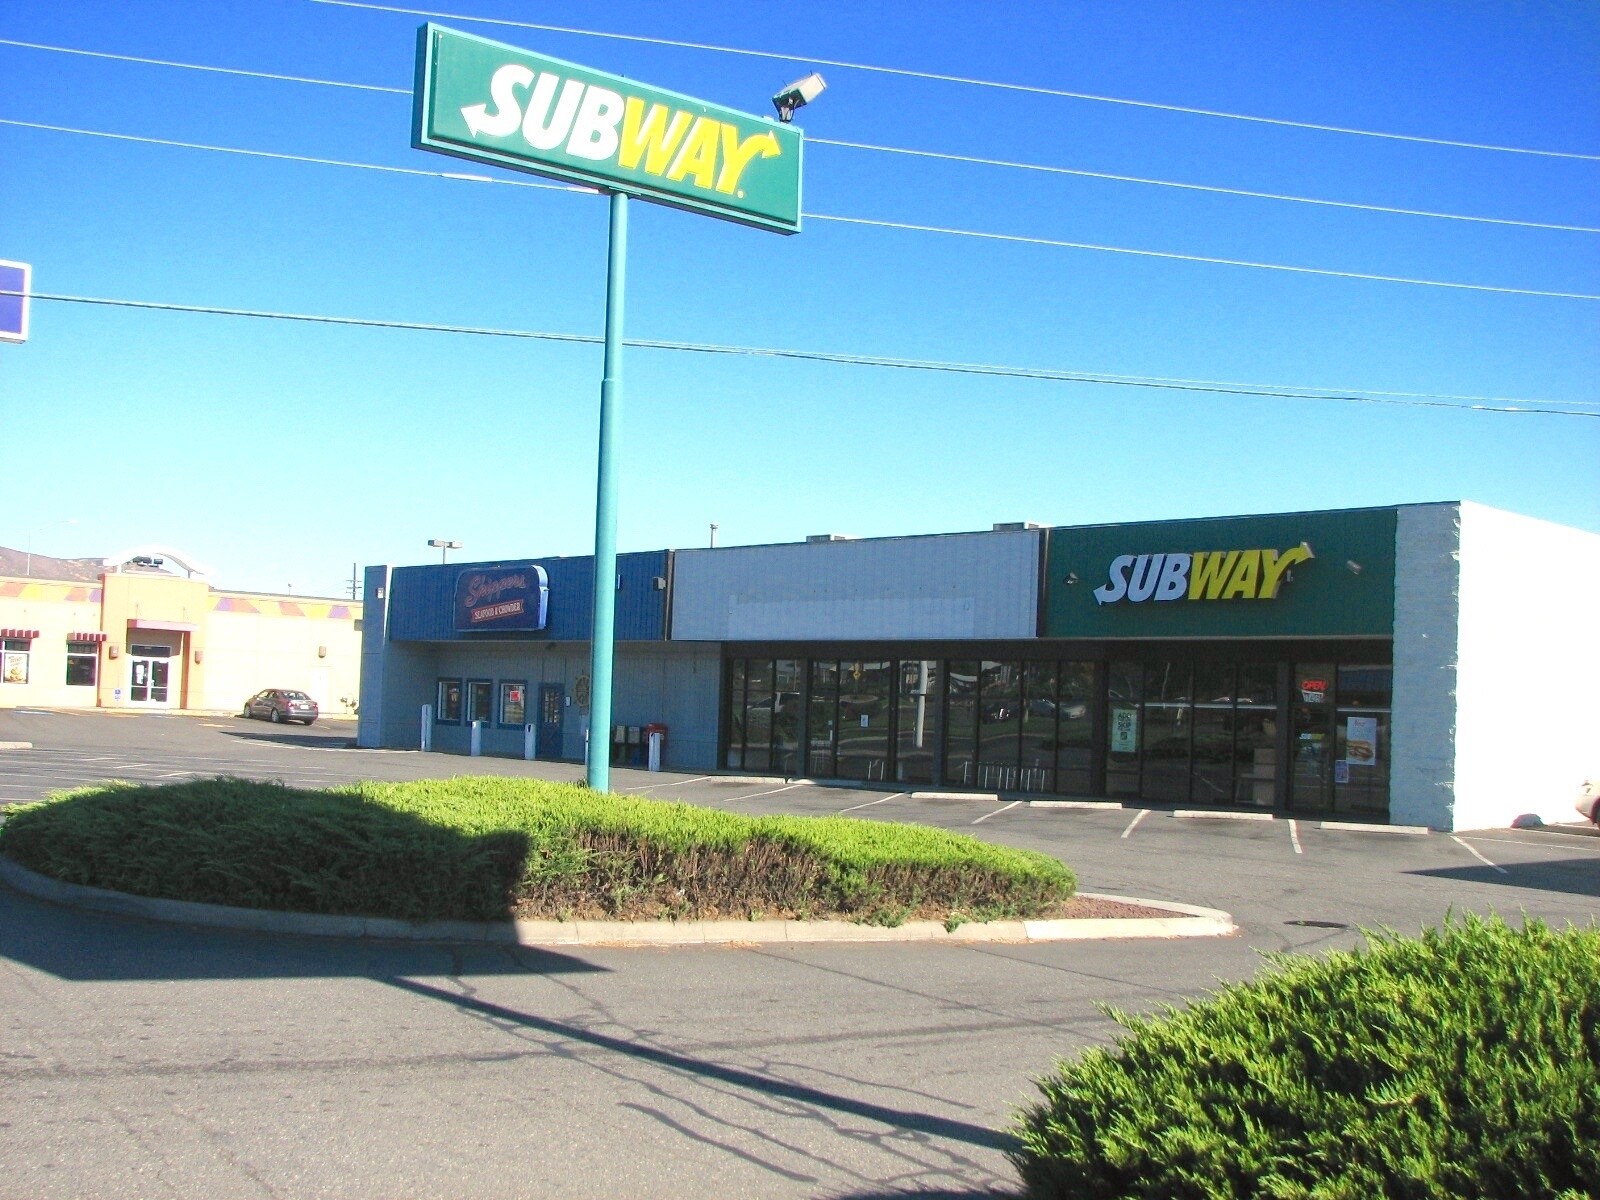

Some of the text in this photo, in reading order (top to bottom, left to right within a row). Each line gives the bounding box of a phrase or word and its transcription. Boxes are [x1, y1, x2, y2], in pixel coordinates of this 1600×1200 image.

[461, 64, 781, 197] SUBWAY
[1093, 542, 1315, 605] SUBWAY
[475, 608, 494, 619] SEAFOOD
[498, 602, 521, 615] CHOWDER
